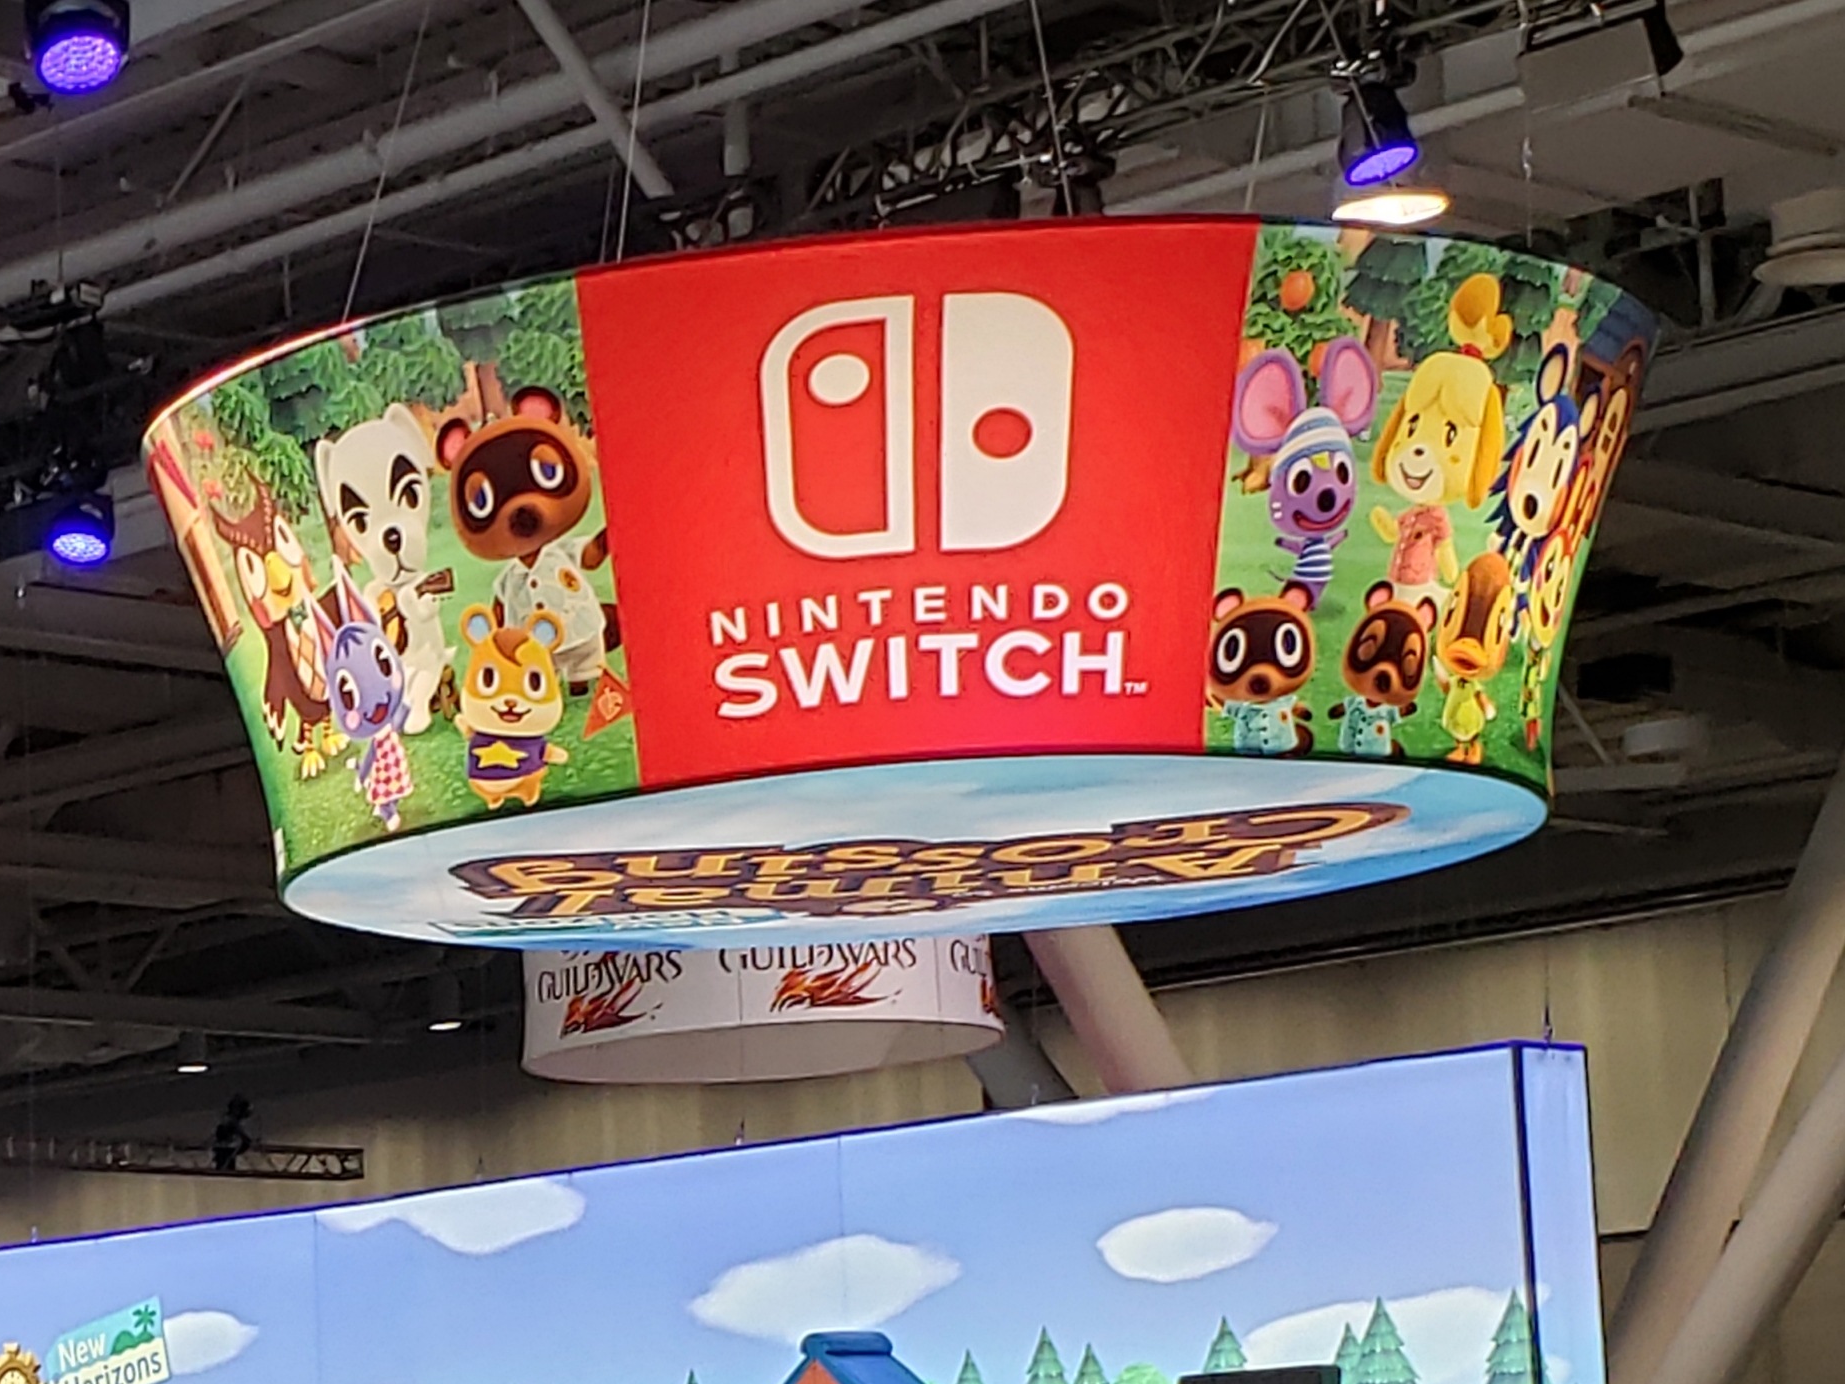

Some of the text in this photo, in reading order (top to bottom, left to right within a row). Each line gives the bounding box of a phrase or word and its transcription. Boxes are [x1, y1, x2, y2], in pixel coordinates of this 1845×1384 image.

[710, 582, 1130, 646] NINTENDO
[714, 629, 1126, 719] SWITCH
[58, 1332, 108, 1371] New
